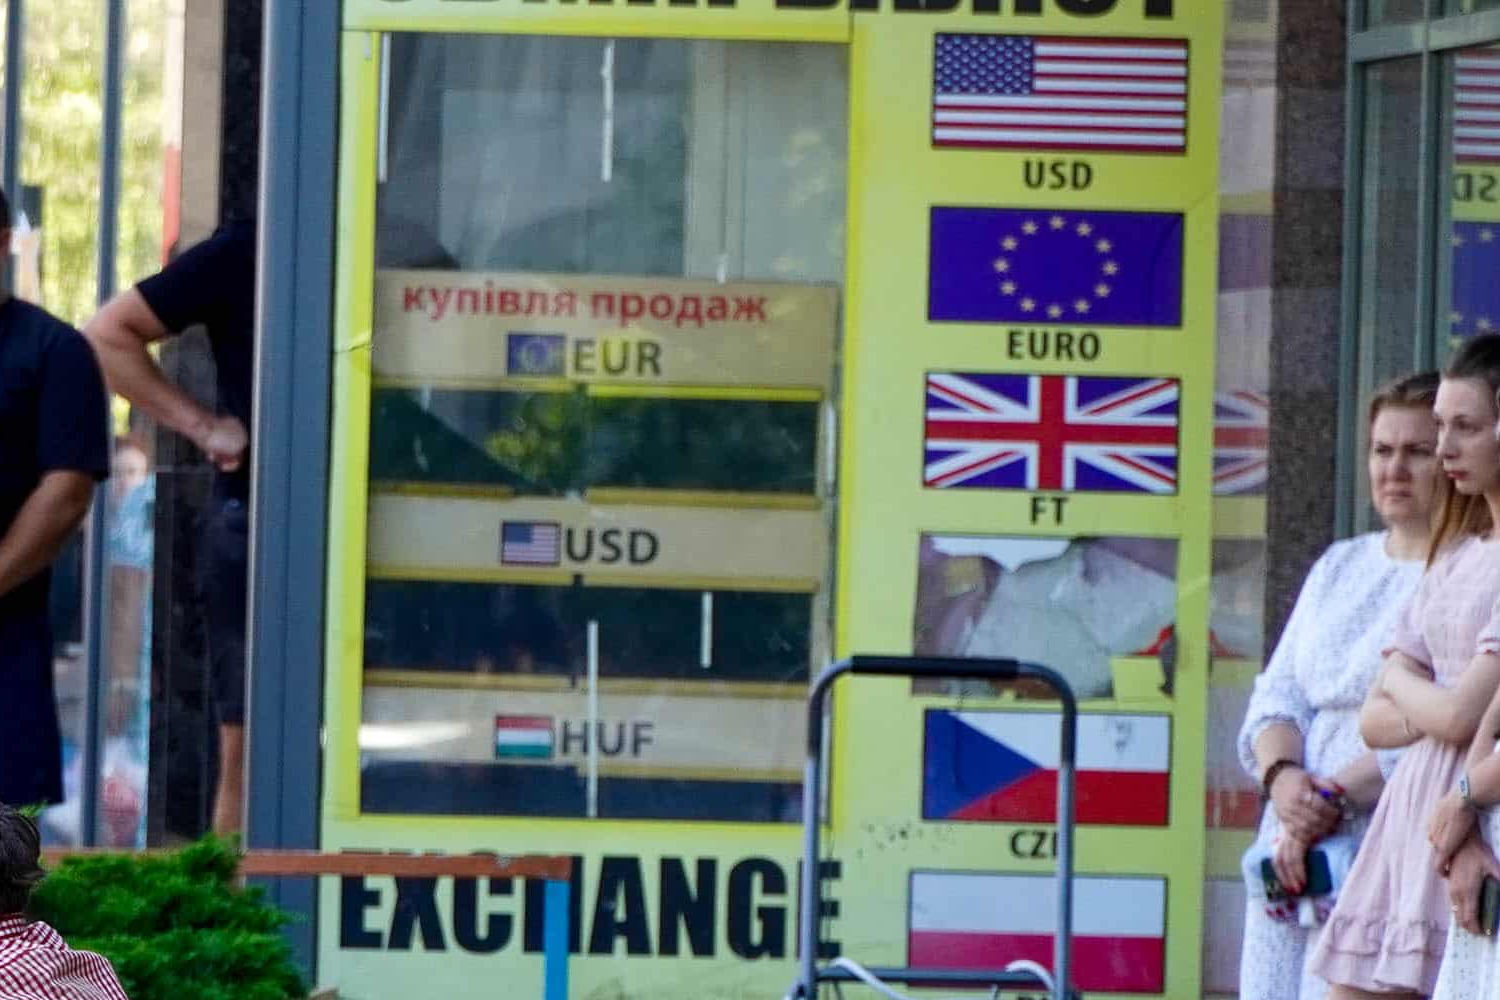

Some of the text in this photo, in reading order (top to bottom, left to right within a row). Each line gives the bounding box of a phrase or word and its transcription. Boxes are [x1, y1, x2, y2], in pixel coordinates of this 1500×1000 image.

[1023, 160, 1093, 190] USD
[403, 279, 769, 327] купівля продаж
[573, 338, 662, 376] EUR
[1008, 330, 1102, 361] EURO
[1030, 496, 1069, 526] FT
[565, 527, 661, 566] USD
[562, 718, 655, 757] HUF
[339, 848, 843, 961] EXCHANGE
